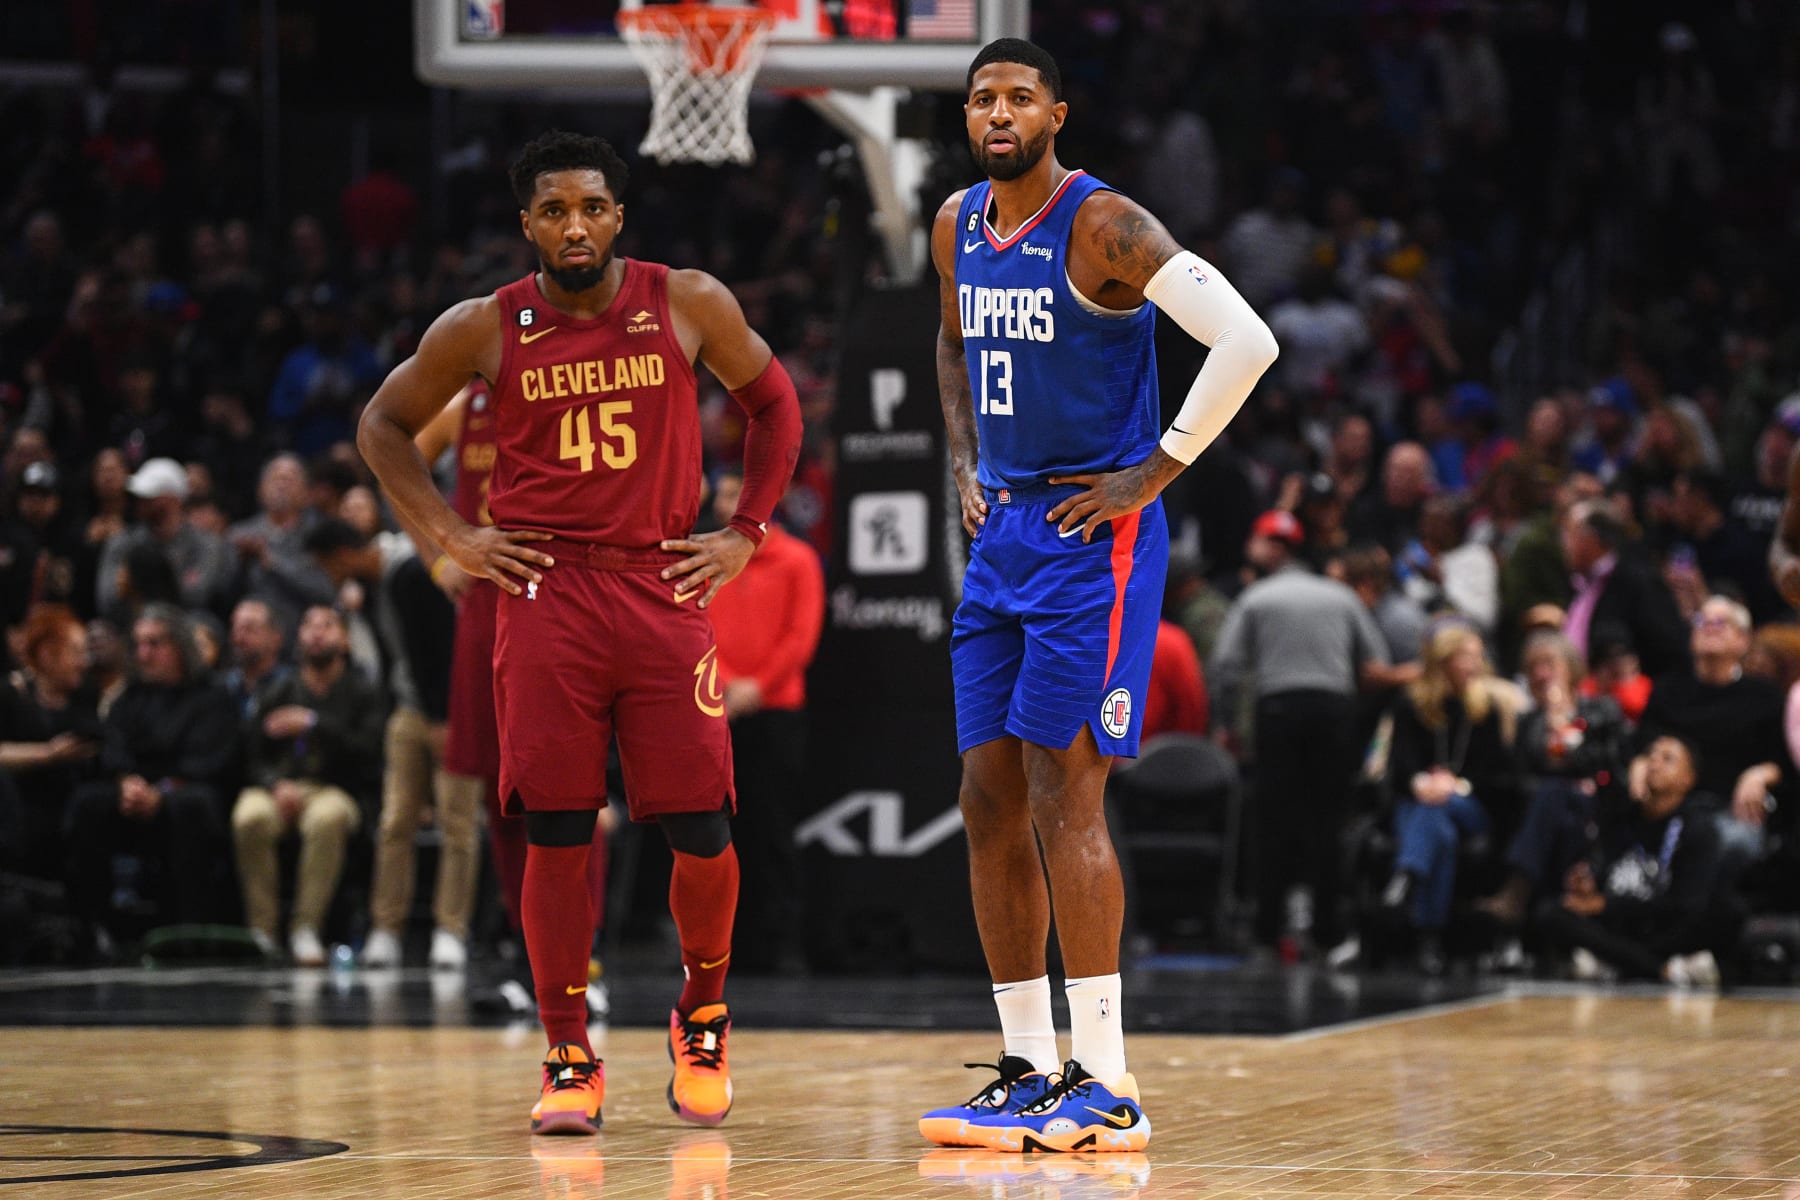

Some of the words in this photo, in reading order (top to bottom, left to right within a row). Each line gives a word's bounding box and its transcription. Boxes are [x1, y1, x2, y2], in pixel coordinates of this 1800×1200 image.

[968, 213, 978, 231] 6
[1021, 242, 1052, 261] honey
[520, 309, 533, 326] 6
[627, 323, 660, 333] CLIFFS
[958, 283, 1055, 342] CLIPPERS
[520, 353, 665, 401] CLEVELAND
[980, 349, 1014, 416] 13
[559, 400, 637, 473] 45
